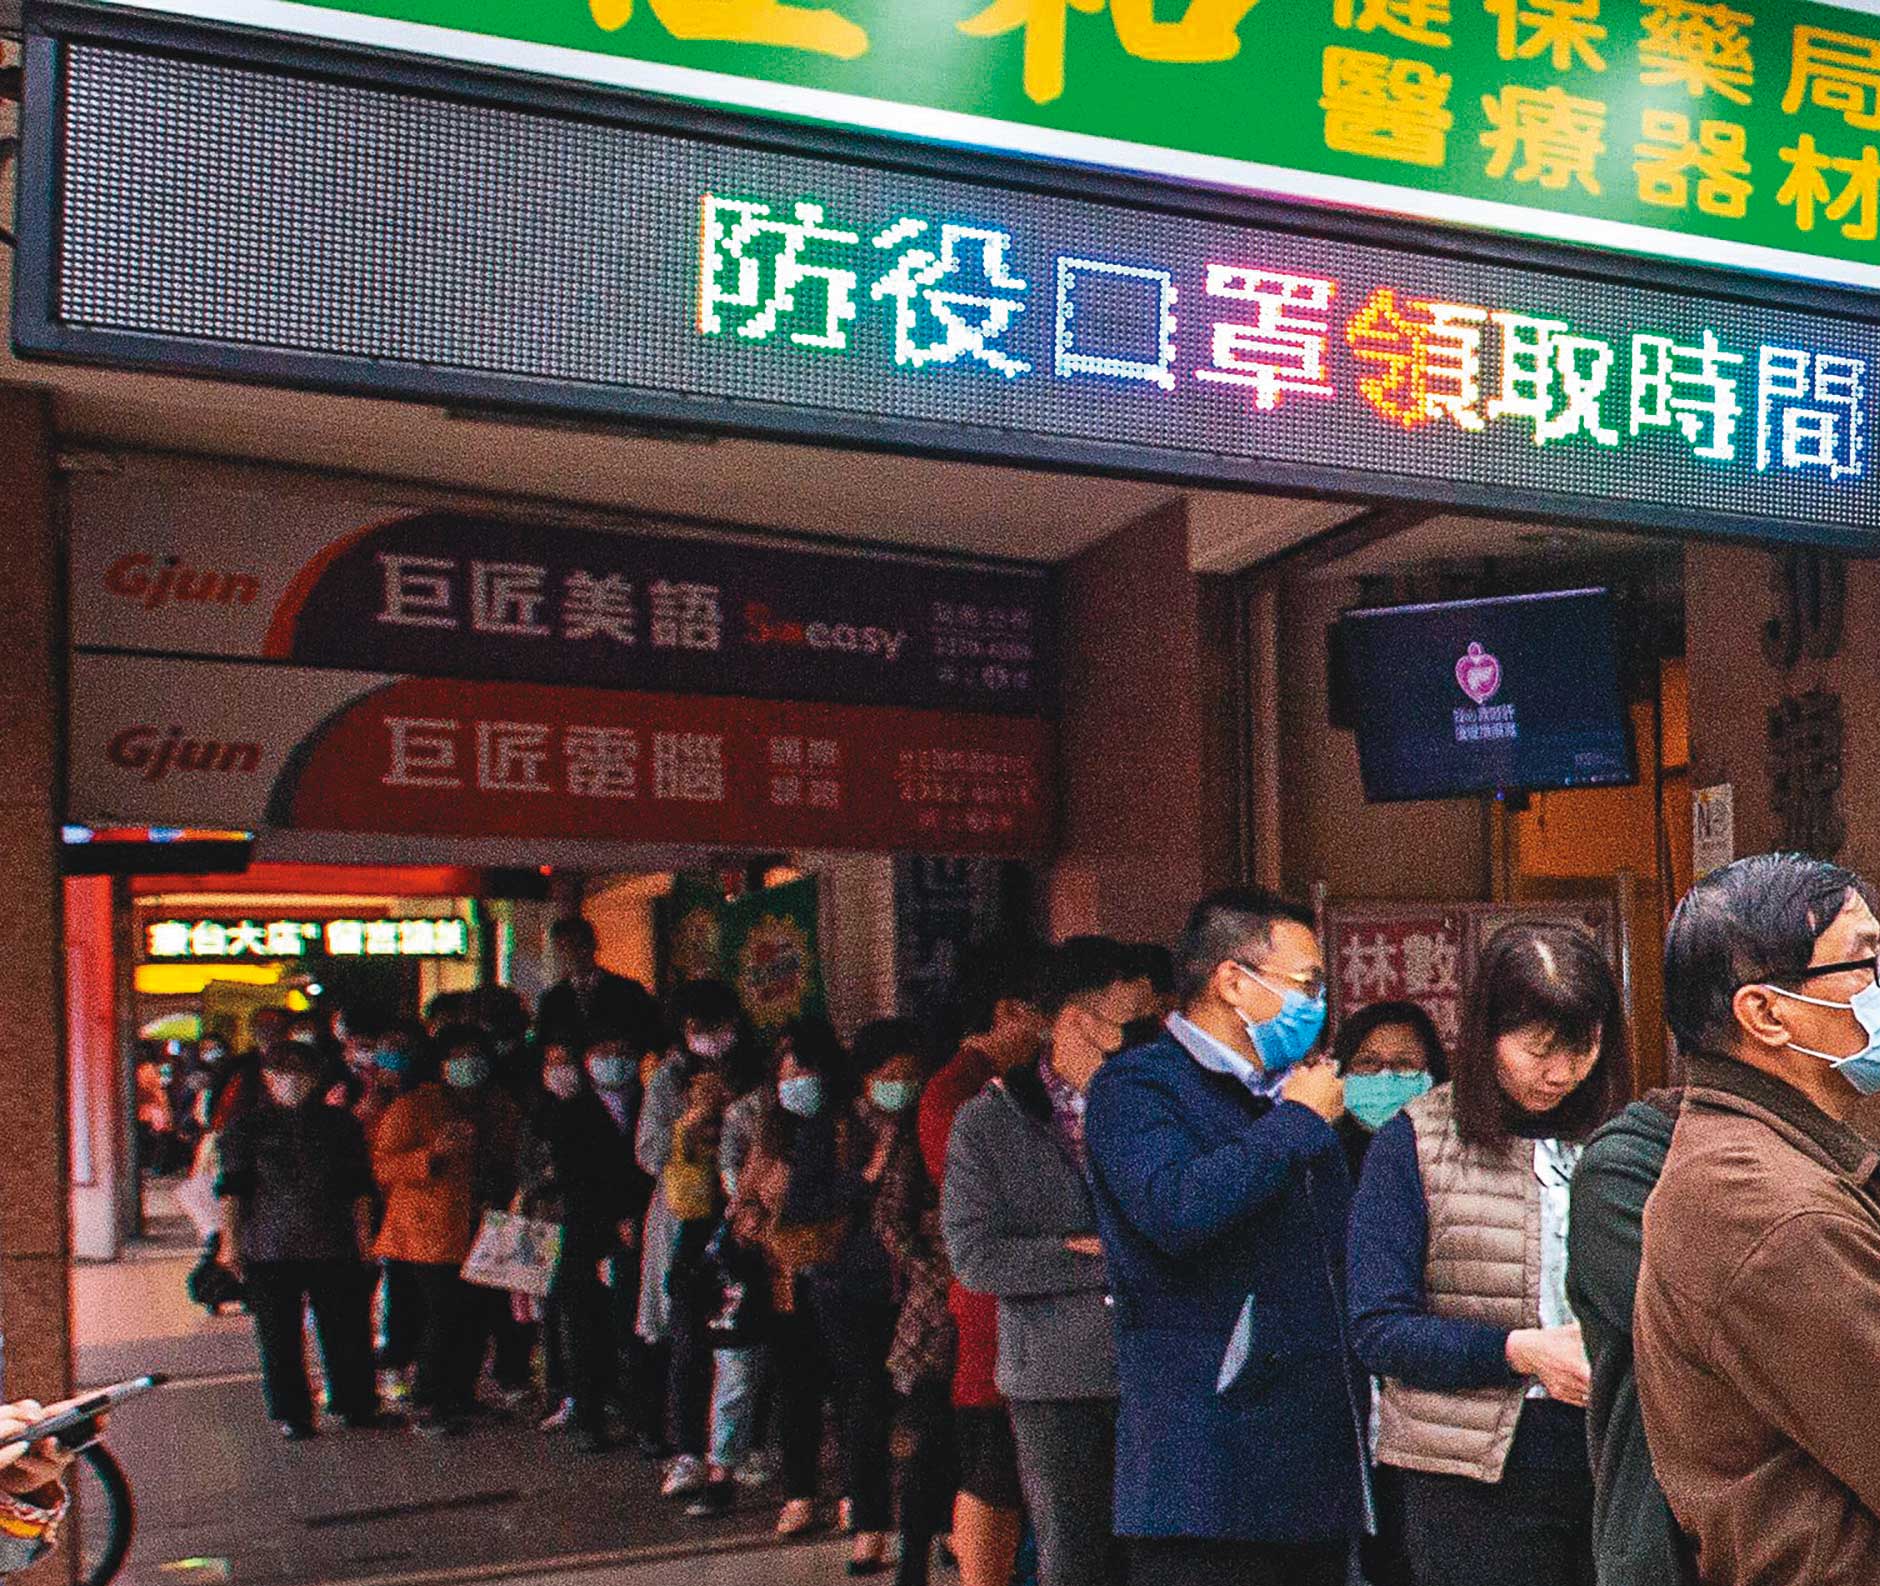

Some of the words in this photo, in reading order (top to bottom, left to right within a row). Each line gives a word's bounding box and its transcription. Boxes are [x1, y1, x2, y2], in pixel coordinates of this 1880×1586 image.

[698, 195, 1866, 482] 防役口罩領取時間
[103, 551, 260, 610] Gjun
[374, 552, 722, 653] 巨匠美語
[106, 724, 264, 777] Gjun
[380, 716, 727, 803] 巨匠電腦
